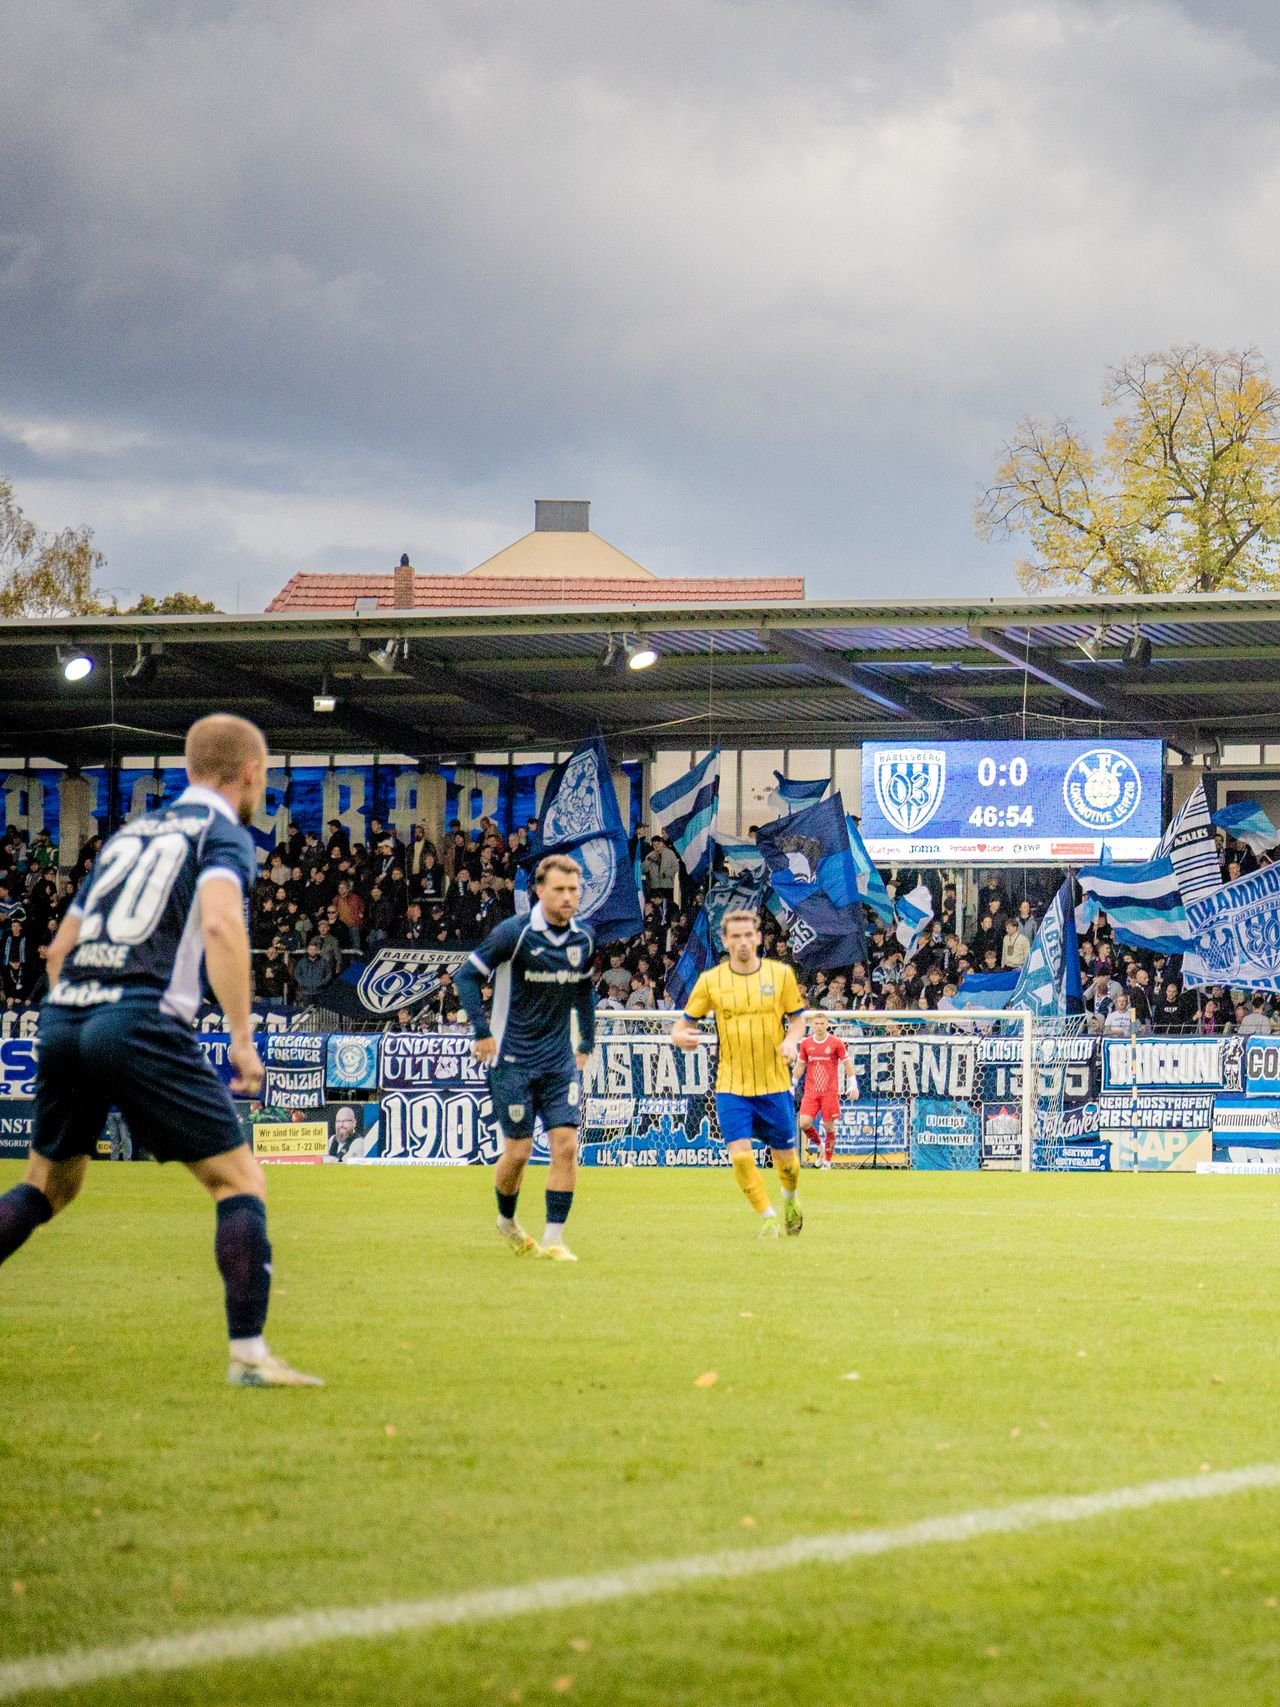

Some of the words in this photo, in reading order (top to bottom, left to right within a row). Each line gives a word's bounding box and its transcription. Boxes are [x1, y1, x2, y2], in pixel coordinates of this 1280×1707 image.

[978, 757, 1028, 786] 0:0
[968, 806, 1034, 827] 46:54
[1023, 845, 1041, 853] EWP
[76, 832, 190, 944] 20
[267, 1035, 323, 1049] FREAKS
[384, 1038, 476, 1055] UNDERD
[268, 1048, 322, 1063] FOREVER
[269, 1072, 321, 1090] POLIZIA
[835, 1111, 895, 1125] ERTA
[260, 1128, 271, 1137] Wir
[273, 1129, 287, 1137] sind
[289, 1128, 299, 1136] für
[301, 1128, 311, 1136] Sie
[313, 1127, 323, 1136] da!
[256, 1144, 268, 1152] Mo.
[270, 1144, 280, 1152] bis
[296, 1142, 312, 1151] 7-22
[314, 1142, 326, 1151] Uhr
[597, 1149, 657, 1166] ULTRAS
